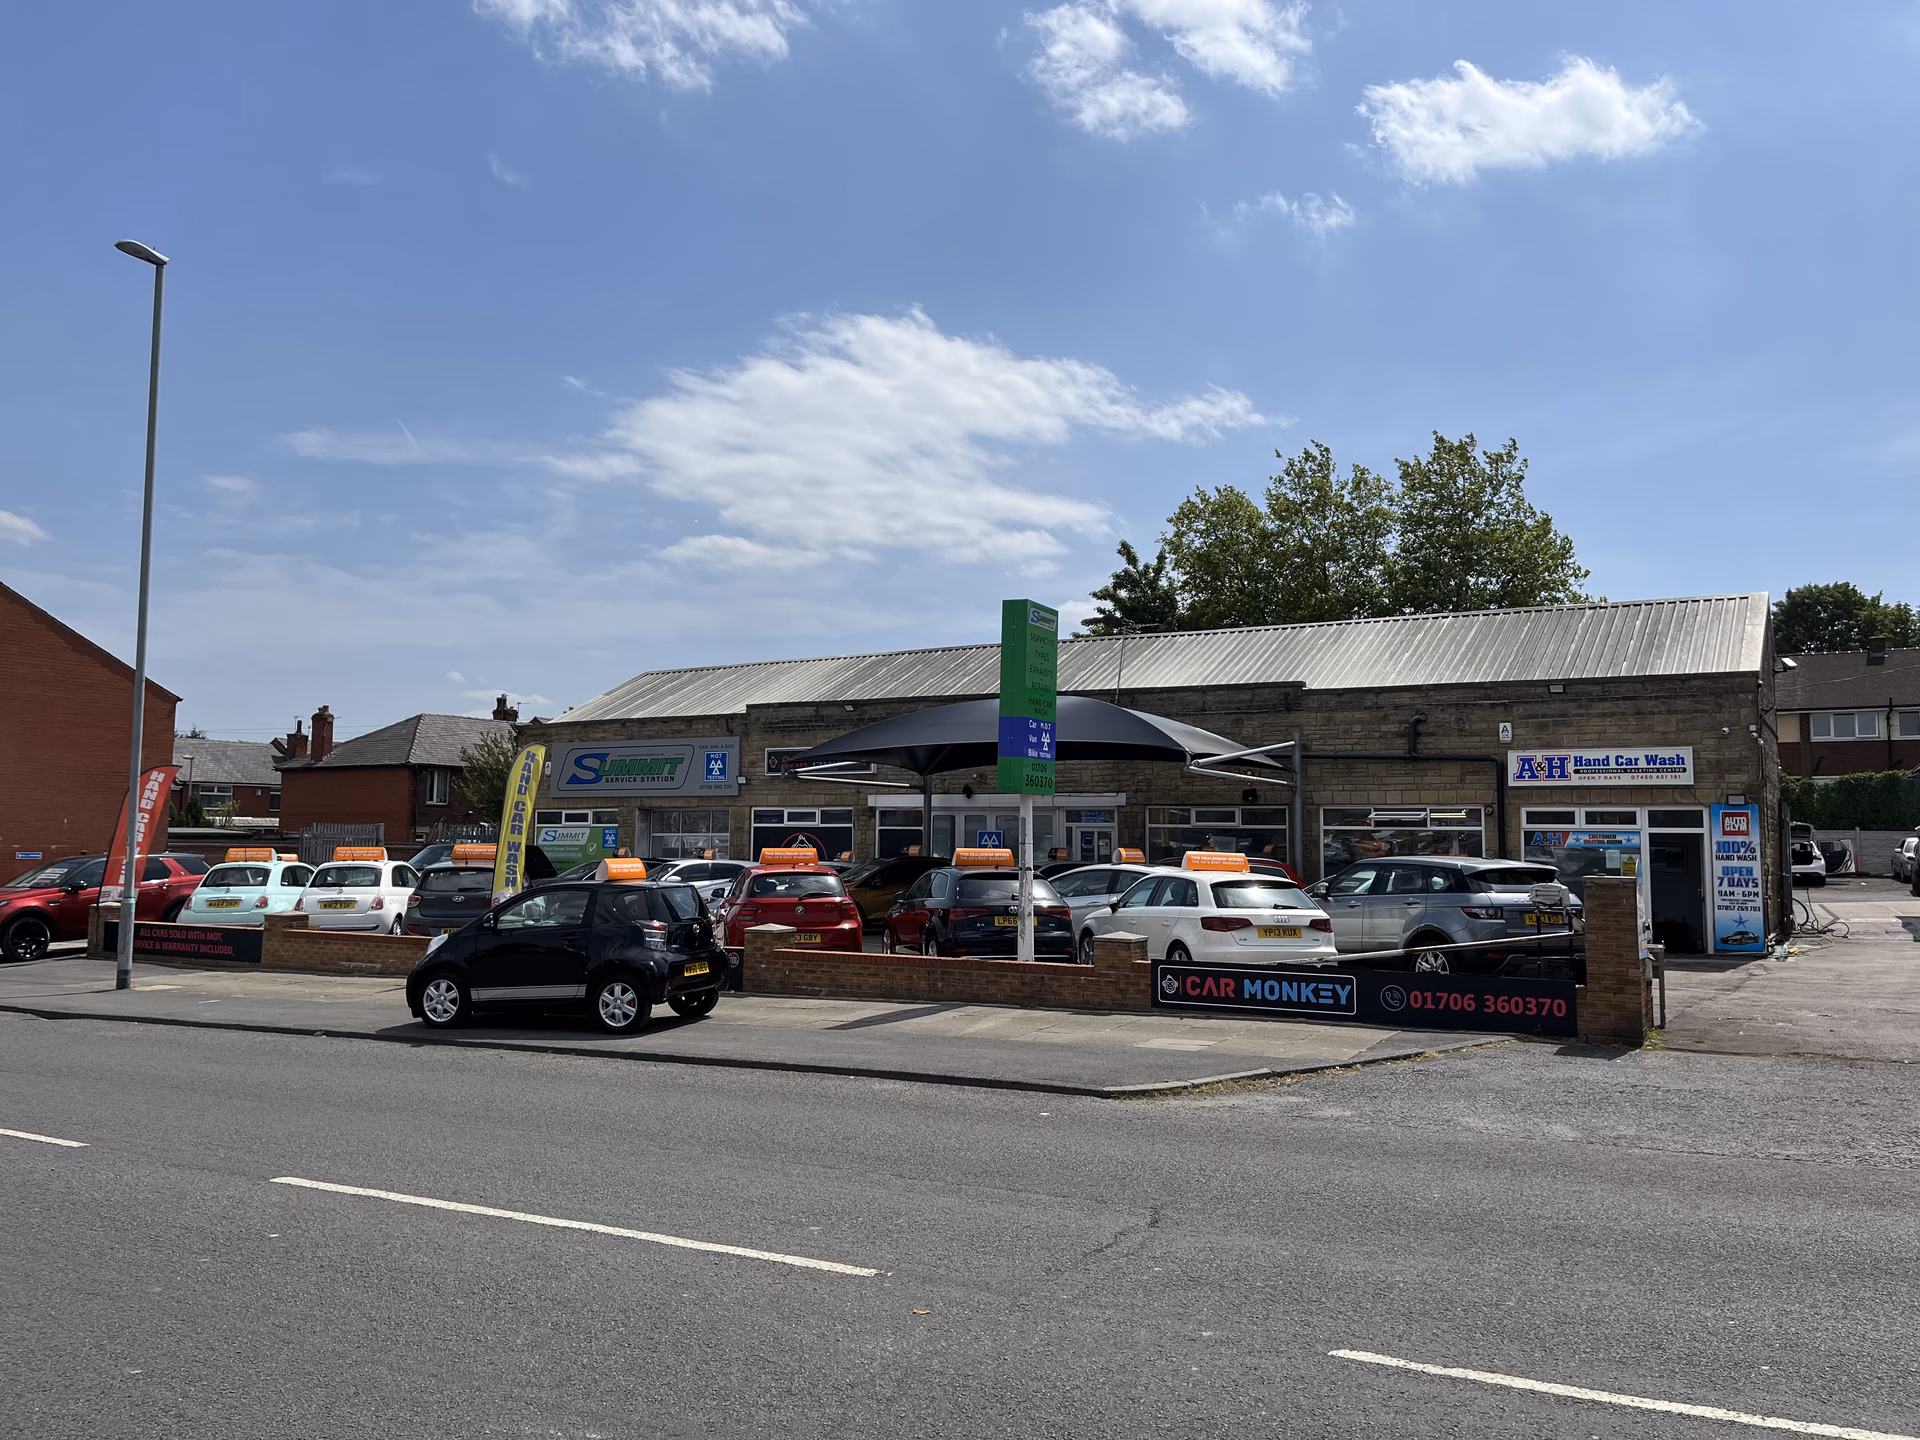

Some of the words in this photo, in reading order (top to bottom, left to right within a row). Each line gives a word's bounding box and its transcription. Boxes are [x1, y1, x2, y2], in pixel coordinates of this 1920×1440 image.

[1030, 633, 1055, 648] SERVICING
[1035, 650, 1050, 661] TYRES
[1029, 664, 1054, 679] EXHAUSTS
[1032, 681, 1051, 693] REPAIRS
[1028, 697, 1042, 706] HAND
[1043, 700, 1053, 709] CAR
[1034, 706, 1048, 716] WASH
[1028, 720, 1037, 728] Car
[1028, 733, 1038, 743] Van
[1028, 748, 1038, 758] Bike
[517, 750, 537, 796] HAND
[565, 753, 685, 785] SUMMIT
[1031, 763, 1048, 773] 01706
[1513, 755, 1572, 782] A&H
[1573, 755, 1610, 767] Hand
[1615, 755, 1640, 766] Car
[1644, 754, 1686, 766] Wash
[640, 775, 675, 783] STATION
[1025, 774, 1053, 789] 360370
[140, 771, 165, 810] HAND
[510, 800, 527, 835] CAR
[1725, 823, 1747, 831] GLYM
[542, 830, 586, 842] SUMMIT
[1715, 841, 1756, 854] 100%
[505, 841, 522, 887] WASH
[1721, 866, 1753, 877] OPEN
[1717, 877, 1725, 887] 7
[1727, 877, 1759, 888] DAYS
[1742, 890, 1759, 898] 6PM
[997, 917, 1018, 925] LP66
[140, 927, 151, 937] ALL
[152, 928, 168, 938] CARS
[169, 929, 187, 939] SOLD
[187, 930, 205, 940] WITH
[206, 931, 224, 942] MOT,
[803, 933, 818, 941] GBY
[1263, 928, 1281, 936] YP13
[1282, 928, 1298, 936] KUX
[134, 939, 154, 950] ERVICE
[155, 940, 161, 950] &
[161, 940, 198, 953] WARRANTY
[1185, 975, 1235, 998] CAR
[1243, 979, 1351, 1005] MONKEY
[1409, 991, 1476, 1012] 01706
[1483, 994, 1567, 1017] 360370
